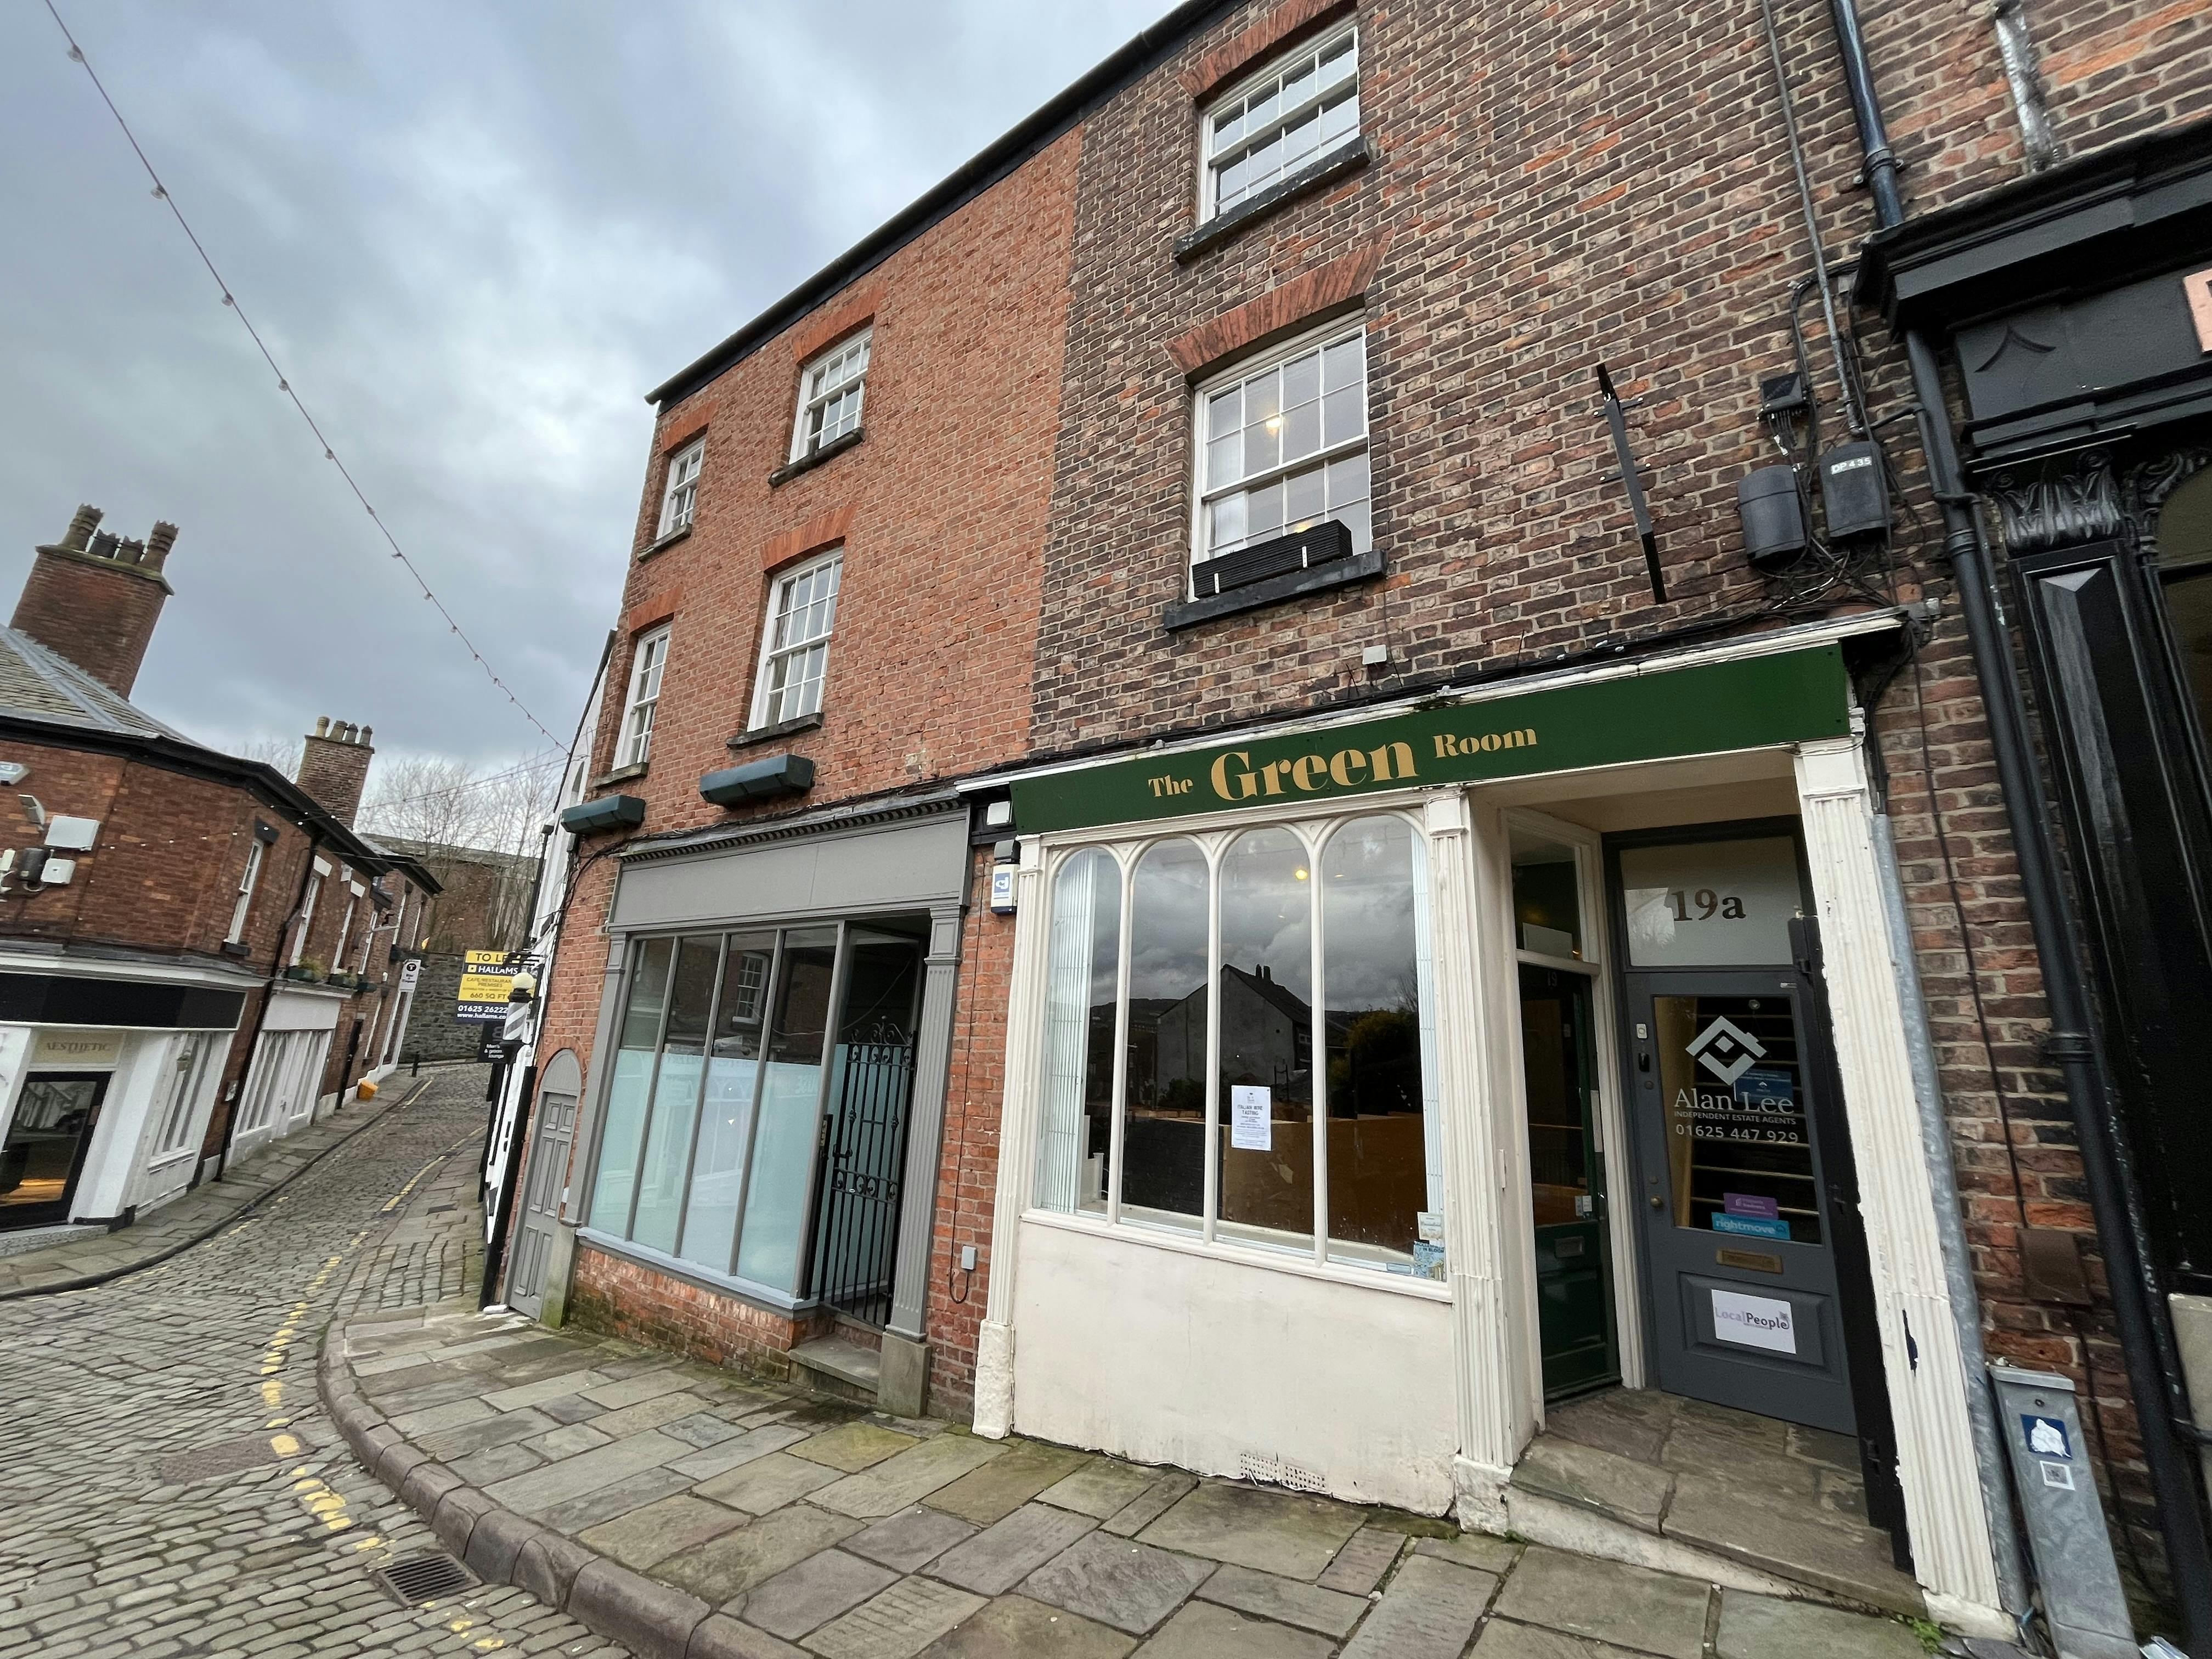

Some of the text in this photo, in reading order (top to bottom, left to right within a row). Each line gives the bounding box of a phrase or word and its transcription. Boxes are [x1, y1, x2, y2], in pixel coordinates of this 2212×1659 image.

[1147, 728, 1538, 801] The Green Room
[1671, 889, 1746, 922] 19a
[476, 953, 492, 962] TO
[478, 966, 518, 974] HALLAMS
[484, 1006, 508, 1014] 26222
[1674, 1088, 1795, 1115] Alan Lee
[1674, 1111, 1797, 1125] INDEPENDENT ESTATE AGENTS
[1675, 1124, 1798, 1143] 01625 447 929
[1716, 1219, 1775, 1234] rightmove
